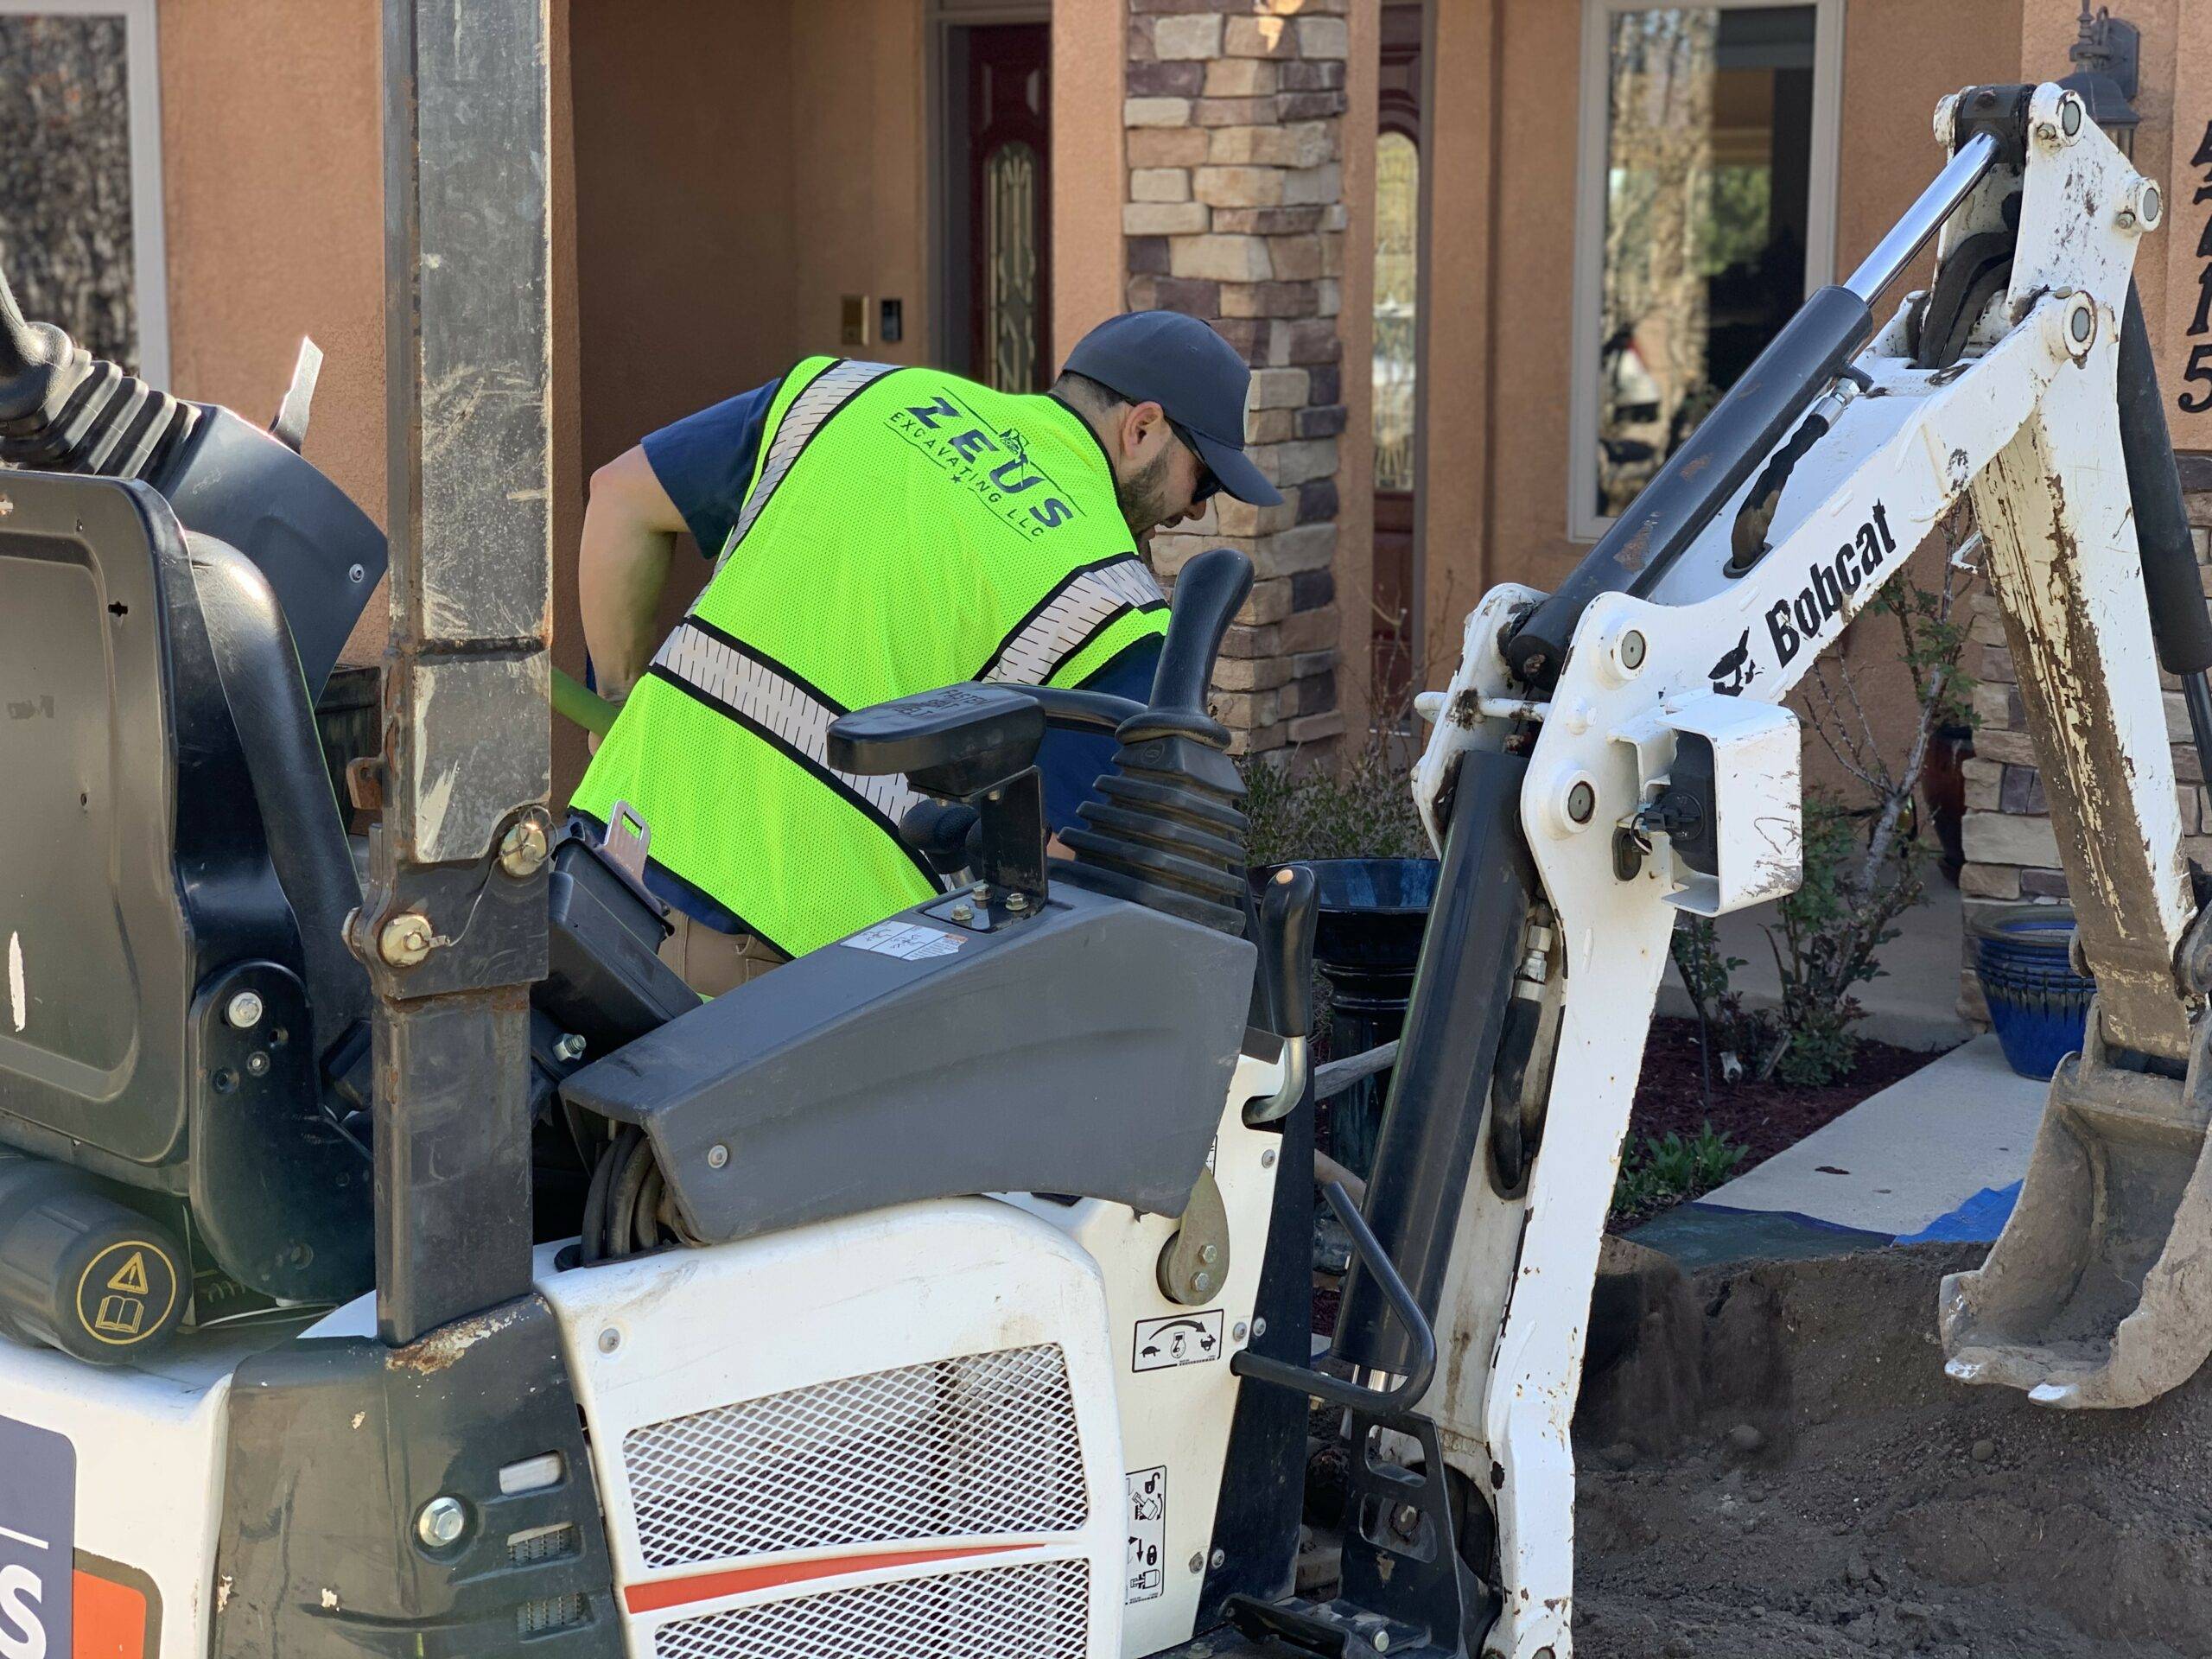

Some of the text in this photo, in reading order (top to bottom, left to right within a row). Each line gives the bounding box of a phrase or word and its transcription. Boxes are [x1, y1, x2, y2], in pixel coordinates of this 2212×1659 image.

[890, 411, 1044, 537] EXCAVATING LLC
[905, 397, 1074, 528] ZEUS
[1765, 498, 1897, 669] Bobcat
